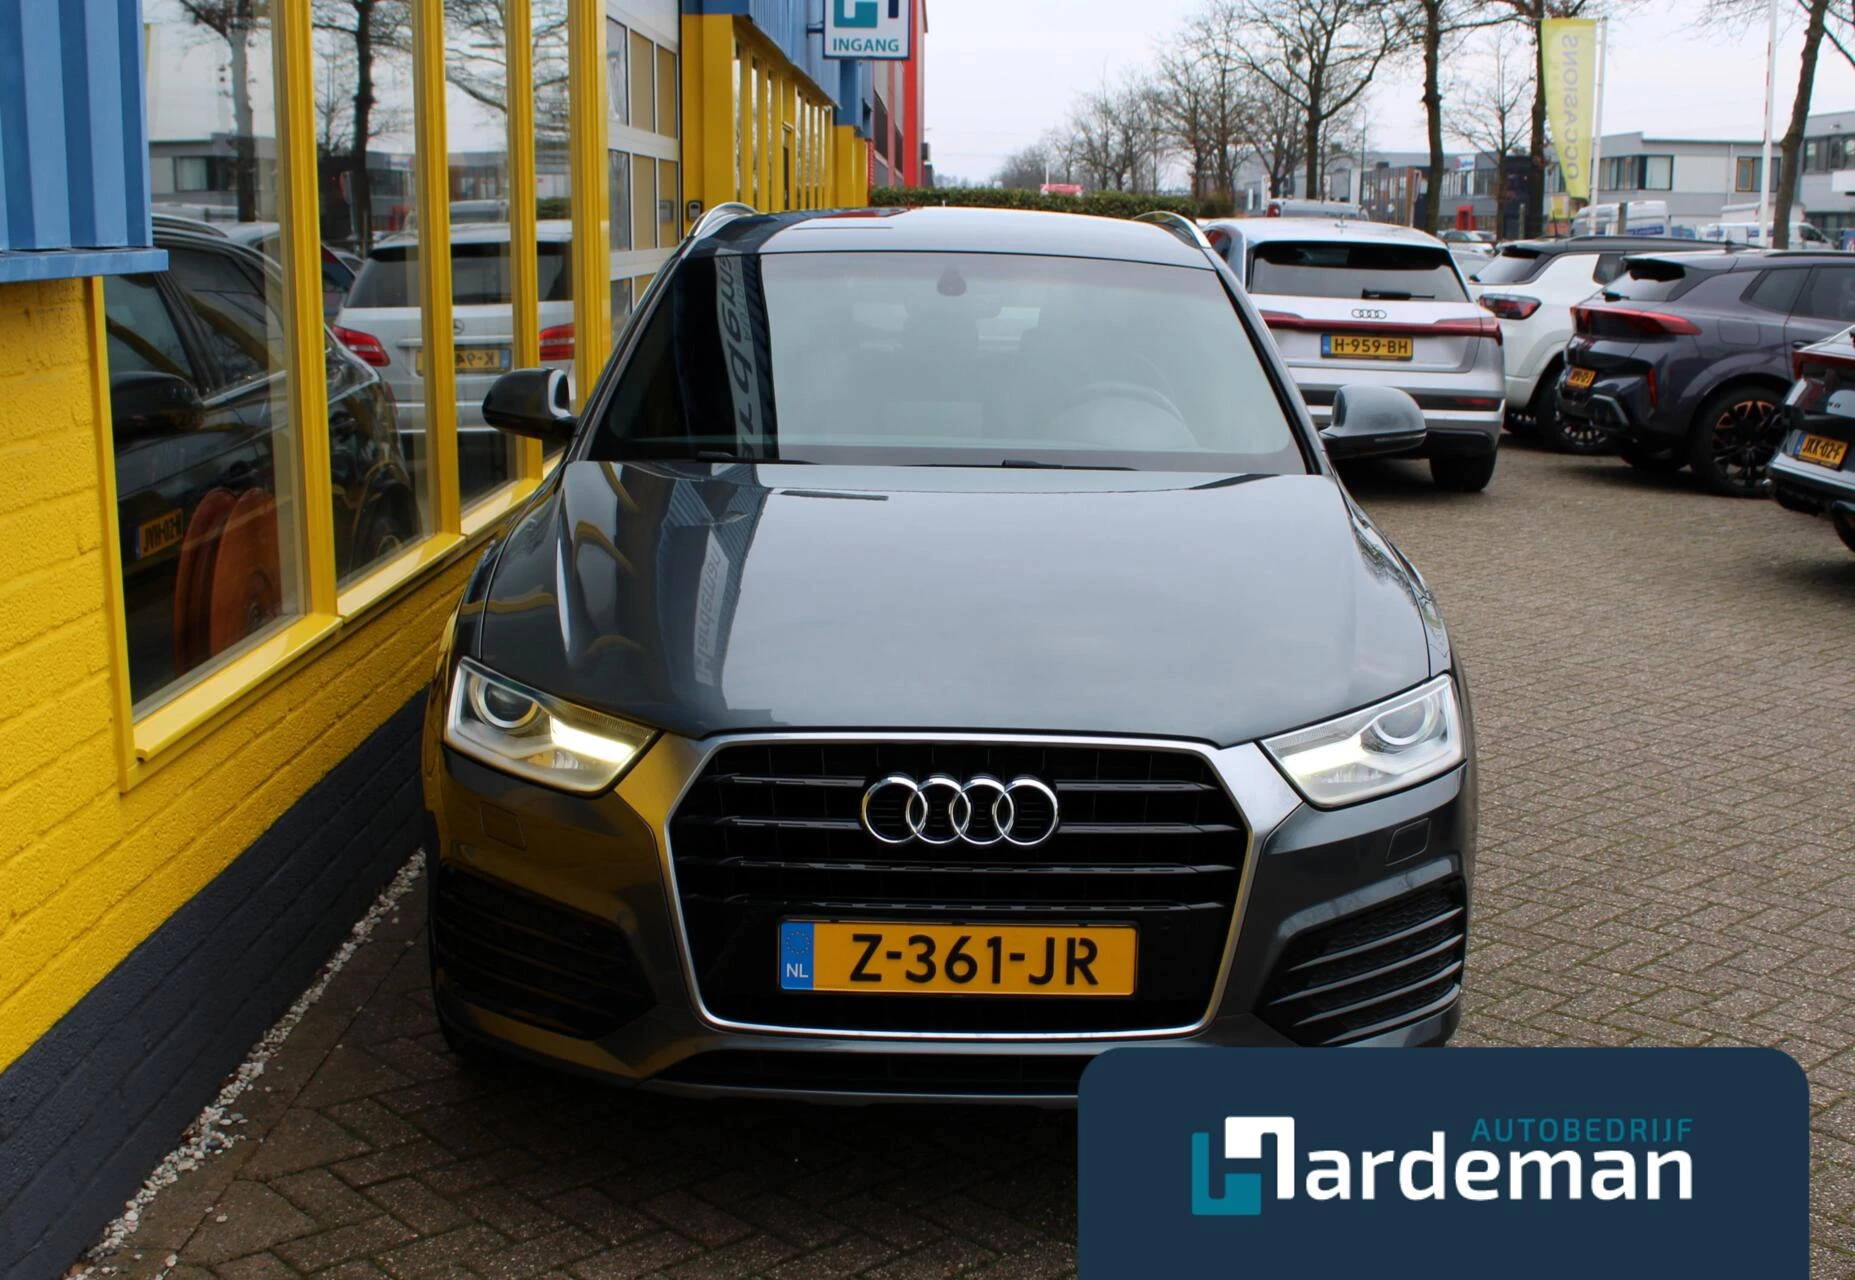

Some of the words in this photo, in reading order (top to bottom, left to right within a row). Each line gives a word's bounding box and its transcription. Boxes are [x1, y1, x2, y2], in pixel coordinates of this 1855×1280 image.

[832, 37, 900, 52] INGANG
[1333, 338, 1408, 354] H-959-BH
[849, 933, 1099, 986] Z-361-JR
[785, 962, 809, 979] NL
